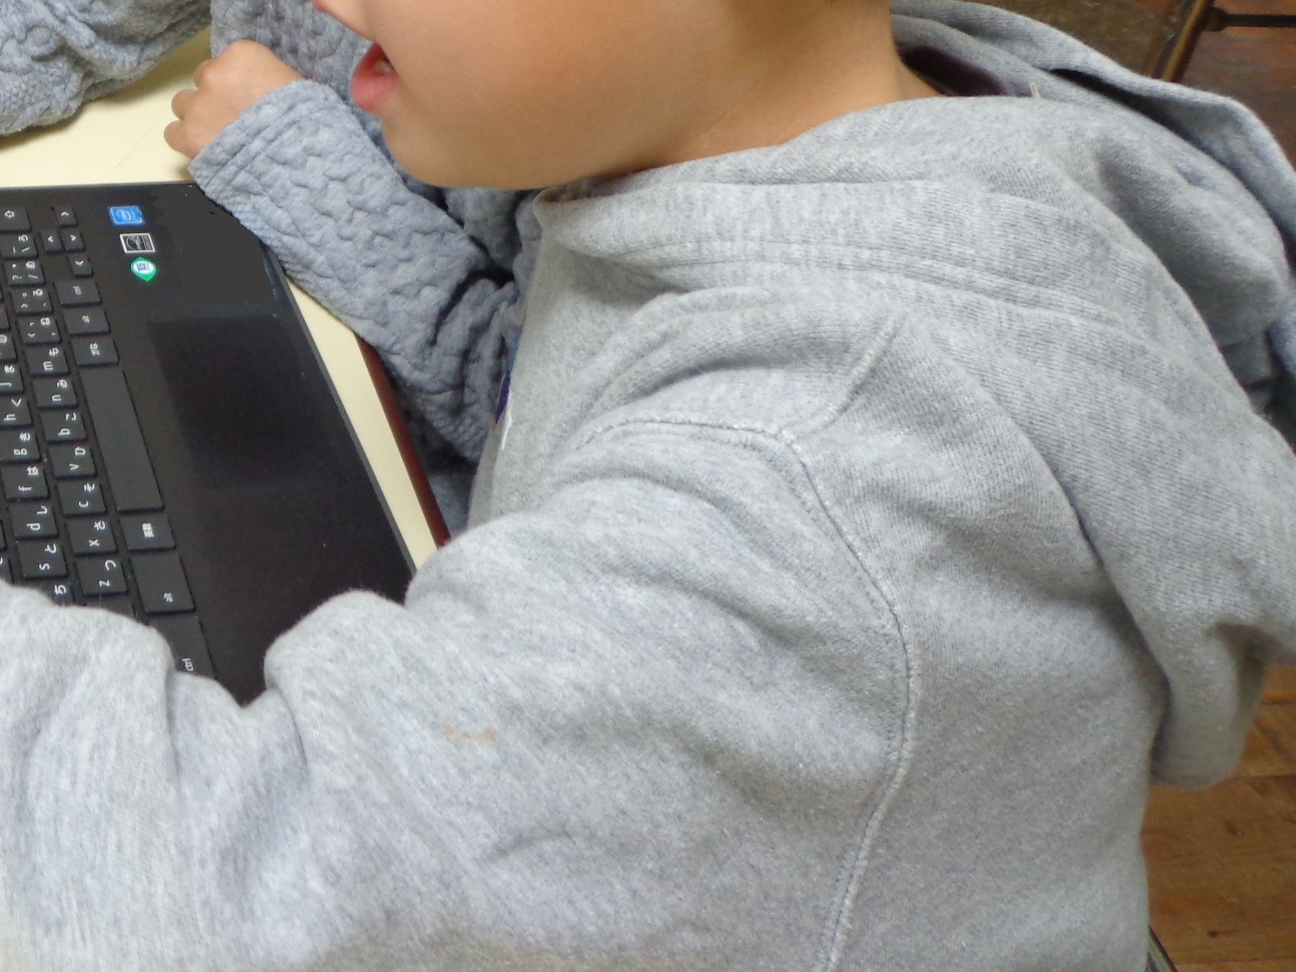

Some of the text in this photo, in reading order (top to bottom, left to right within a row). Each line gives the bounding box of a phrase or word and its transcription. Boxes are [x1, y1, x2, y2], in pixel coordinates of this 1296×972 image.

[43, 361, 54, 372] m
[51, 394, 62, 403] n
[3, 413, 17, 422] h
[57, 428, 71, 437] b
[13, 448, 28, 457] g
[18, 485, 32, 493] f
[26, 522, 41, 531] d
[182, 658, 194, 671] ctrl
